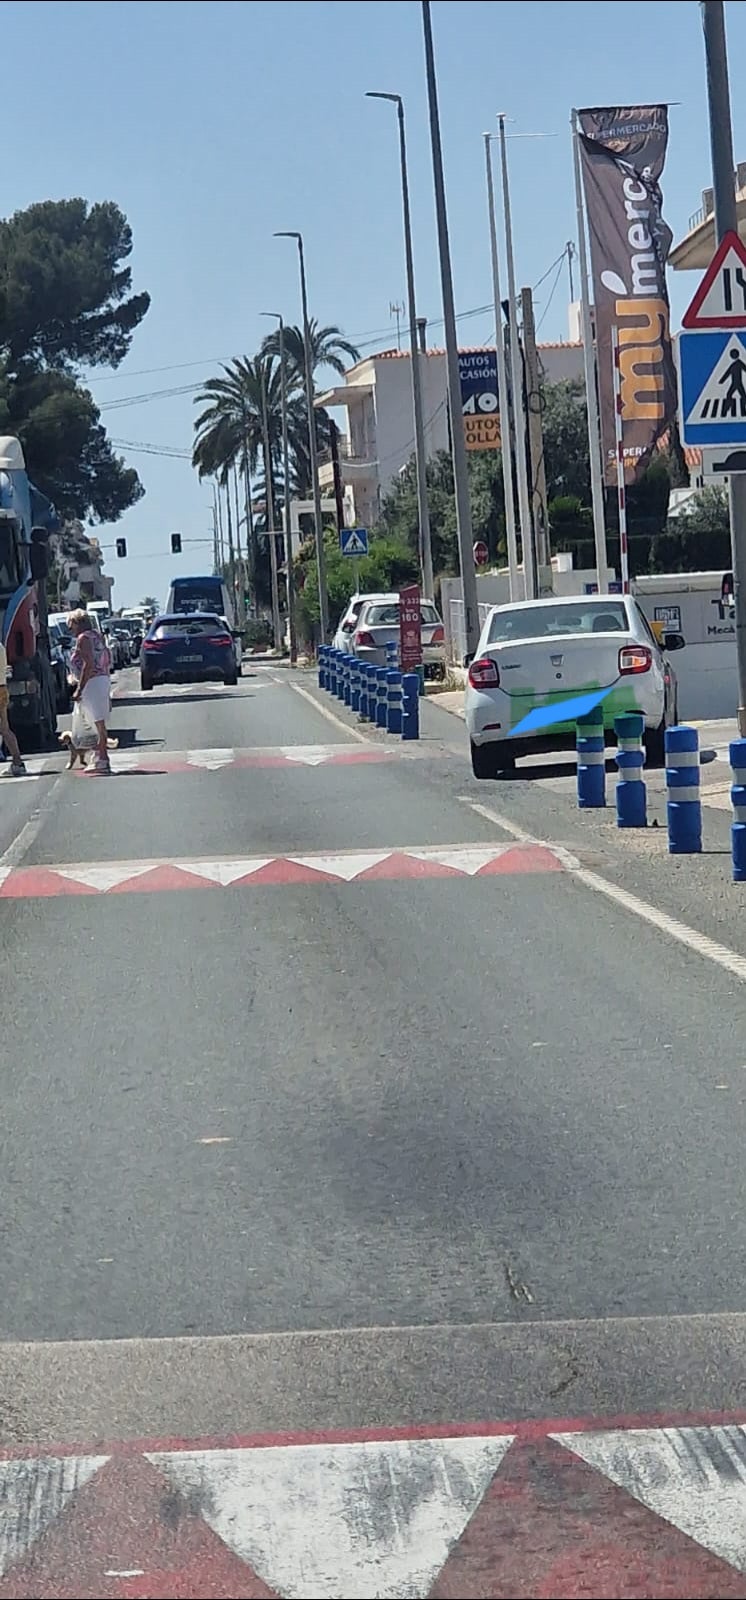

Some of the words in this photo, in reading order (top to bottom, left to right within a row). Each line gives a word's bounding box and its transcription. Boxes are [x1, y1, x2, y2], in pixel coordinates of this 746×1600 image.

[458, 356, 489, 367] AUTOS
[616, 299, 671, 421] my
[460, 367, 497, 380] CASIÓN
[466, 419, 501, 432] UTOS
[466, 431, 502, 444] OLLA
